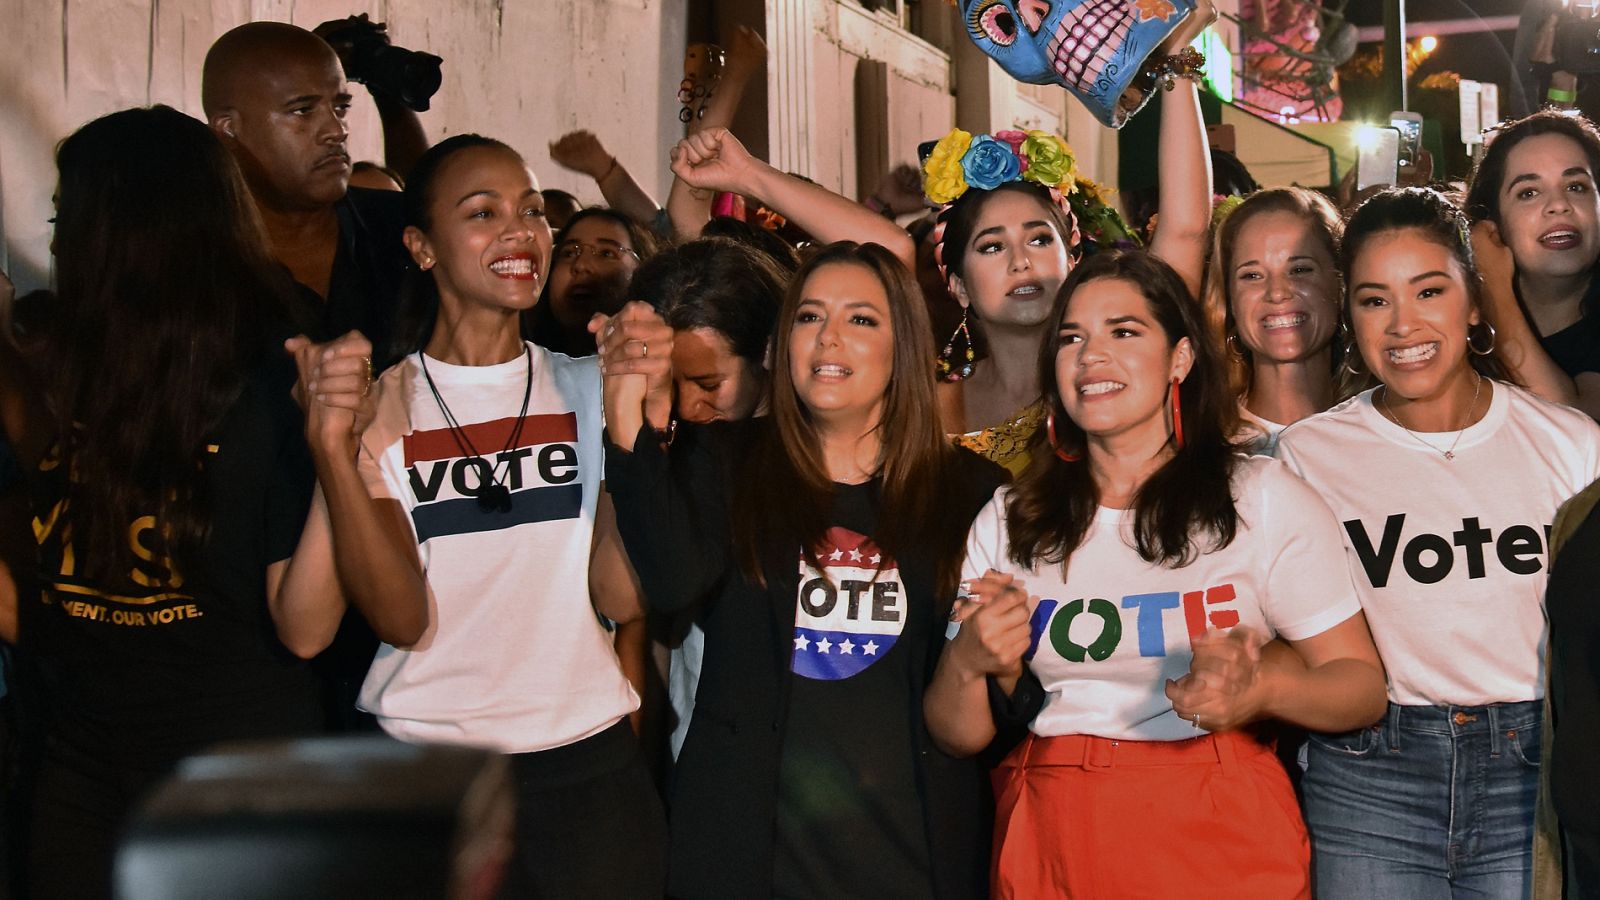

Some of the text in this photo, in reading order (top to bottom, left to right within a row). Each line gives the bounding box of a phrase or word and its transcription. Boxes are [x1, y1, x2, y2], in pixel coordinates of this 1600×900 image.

[112, 609, 146, 626] OUR
[146, 603, 204, 626] VOTE.
[799, 574, 900, 622] OTE
